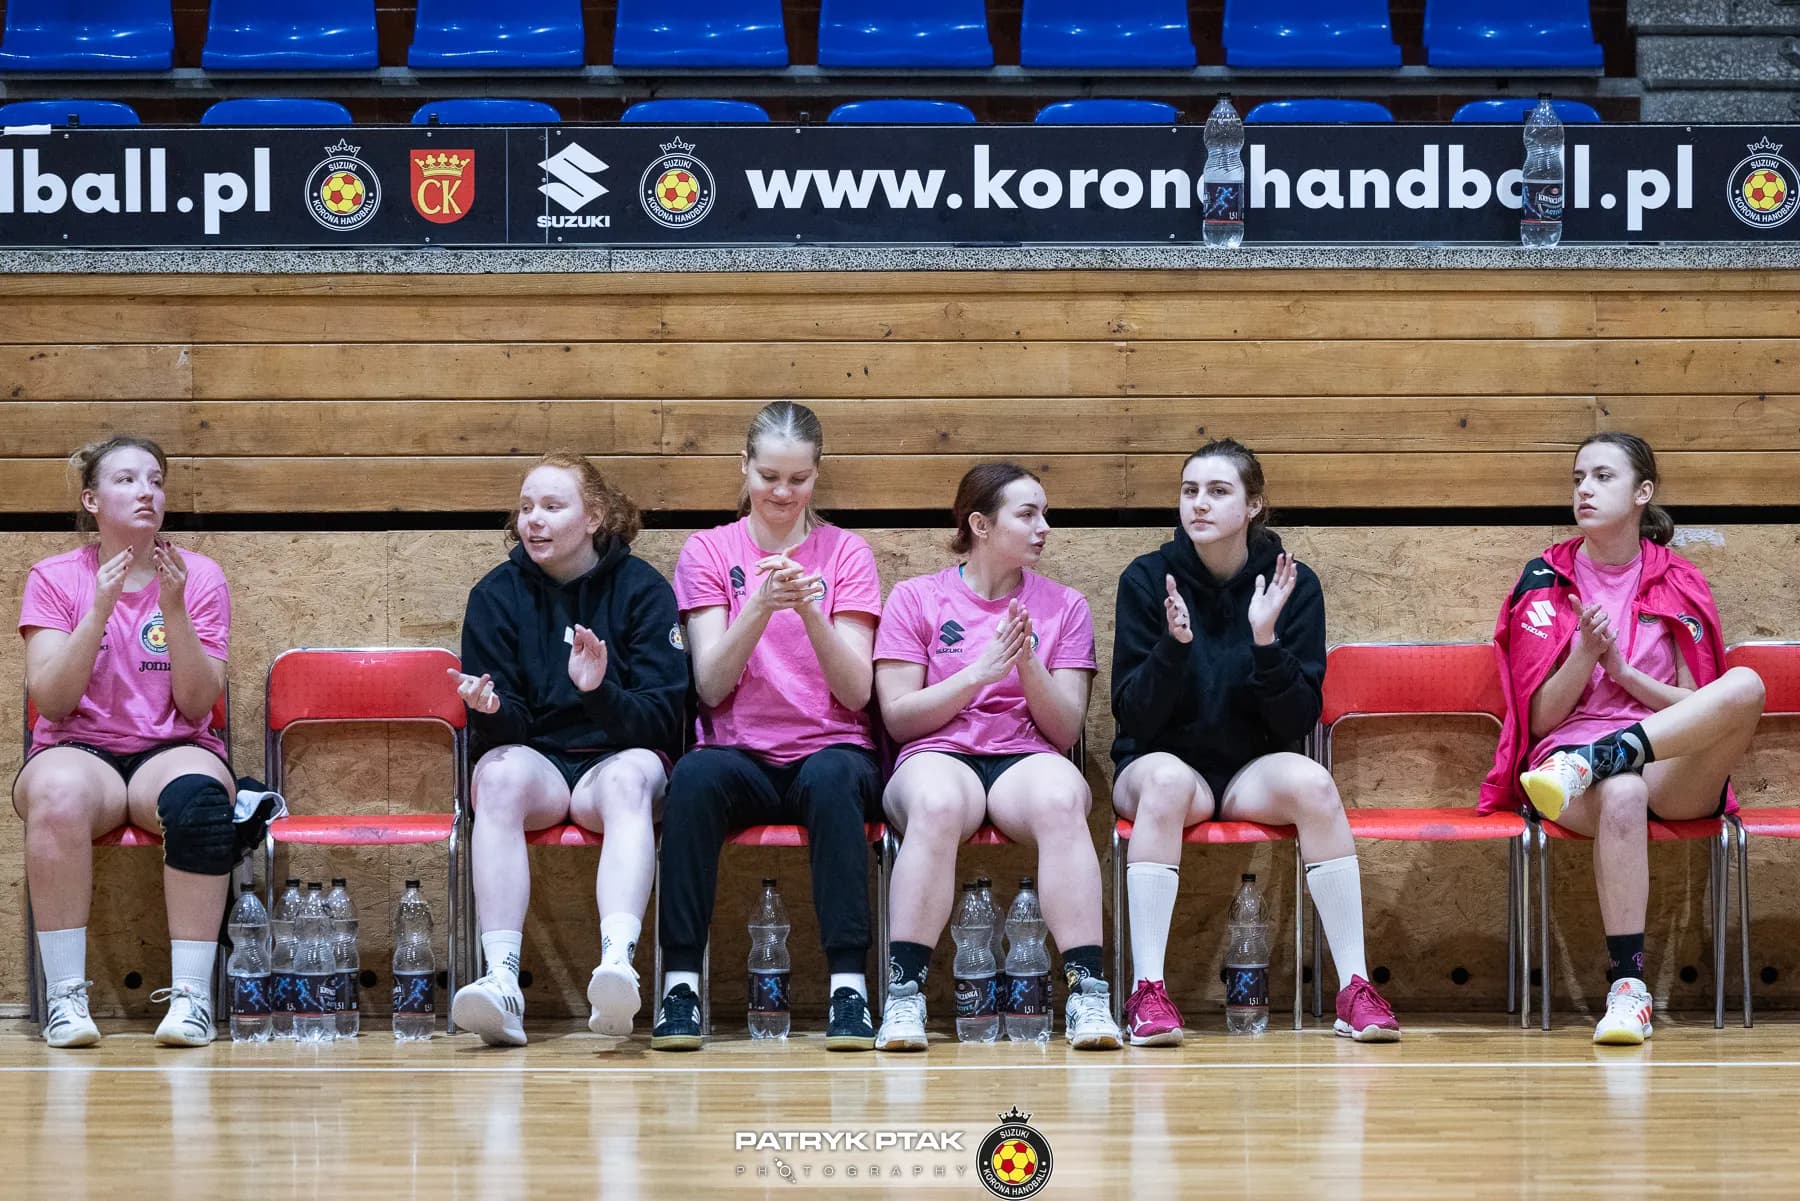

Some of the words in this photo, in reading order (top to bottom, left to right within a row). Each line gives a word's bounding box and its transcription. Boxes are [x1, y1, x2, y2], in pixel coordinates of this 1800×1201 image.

[328, 161, 358, 172] SUZUKI
[663, 159, 693, 170] SUZUKI
[1750, 159, 1780, 170] SUZUKI
[417, 178, 462, 215] CK
[312, 199, 339, 225] KORONA
[340, 198, 375, 225] HANDBALL
[647, 196, 673, 222] KORONA
[674, 196, 709, 223] HANDBALL
[1734, 196, 1760, 222] KORONA
[1761, 196, 1796, 223] HANDBALL
[537, 215, 611, 228] SUZUKI
[1520, 622, 1549, 639] SUZUKI
